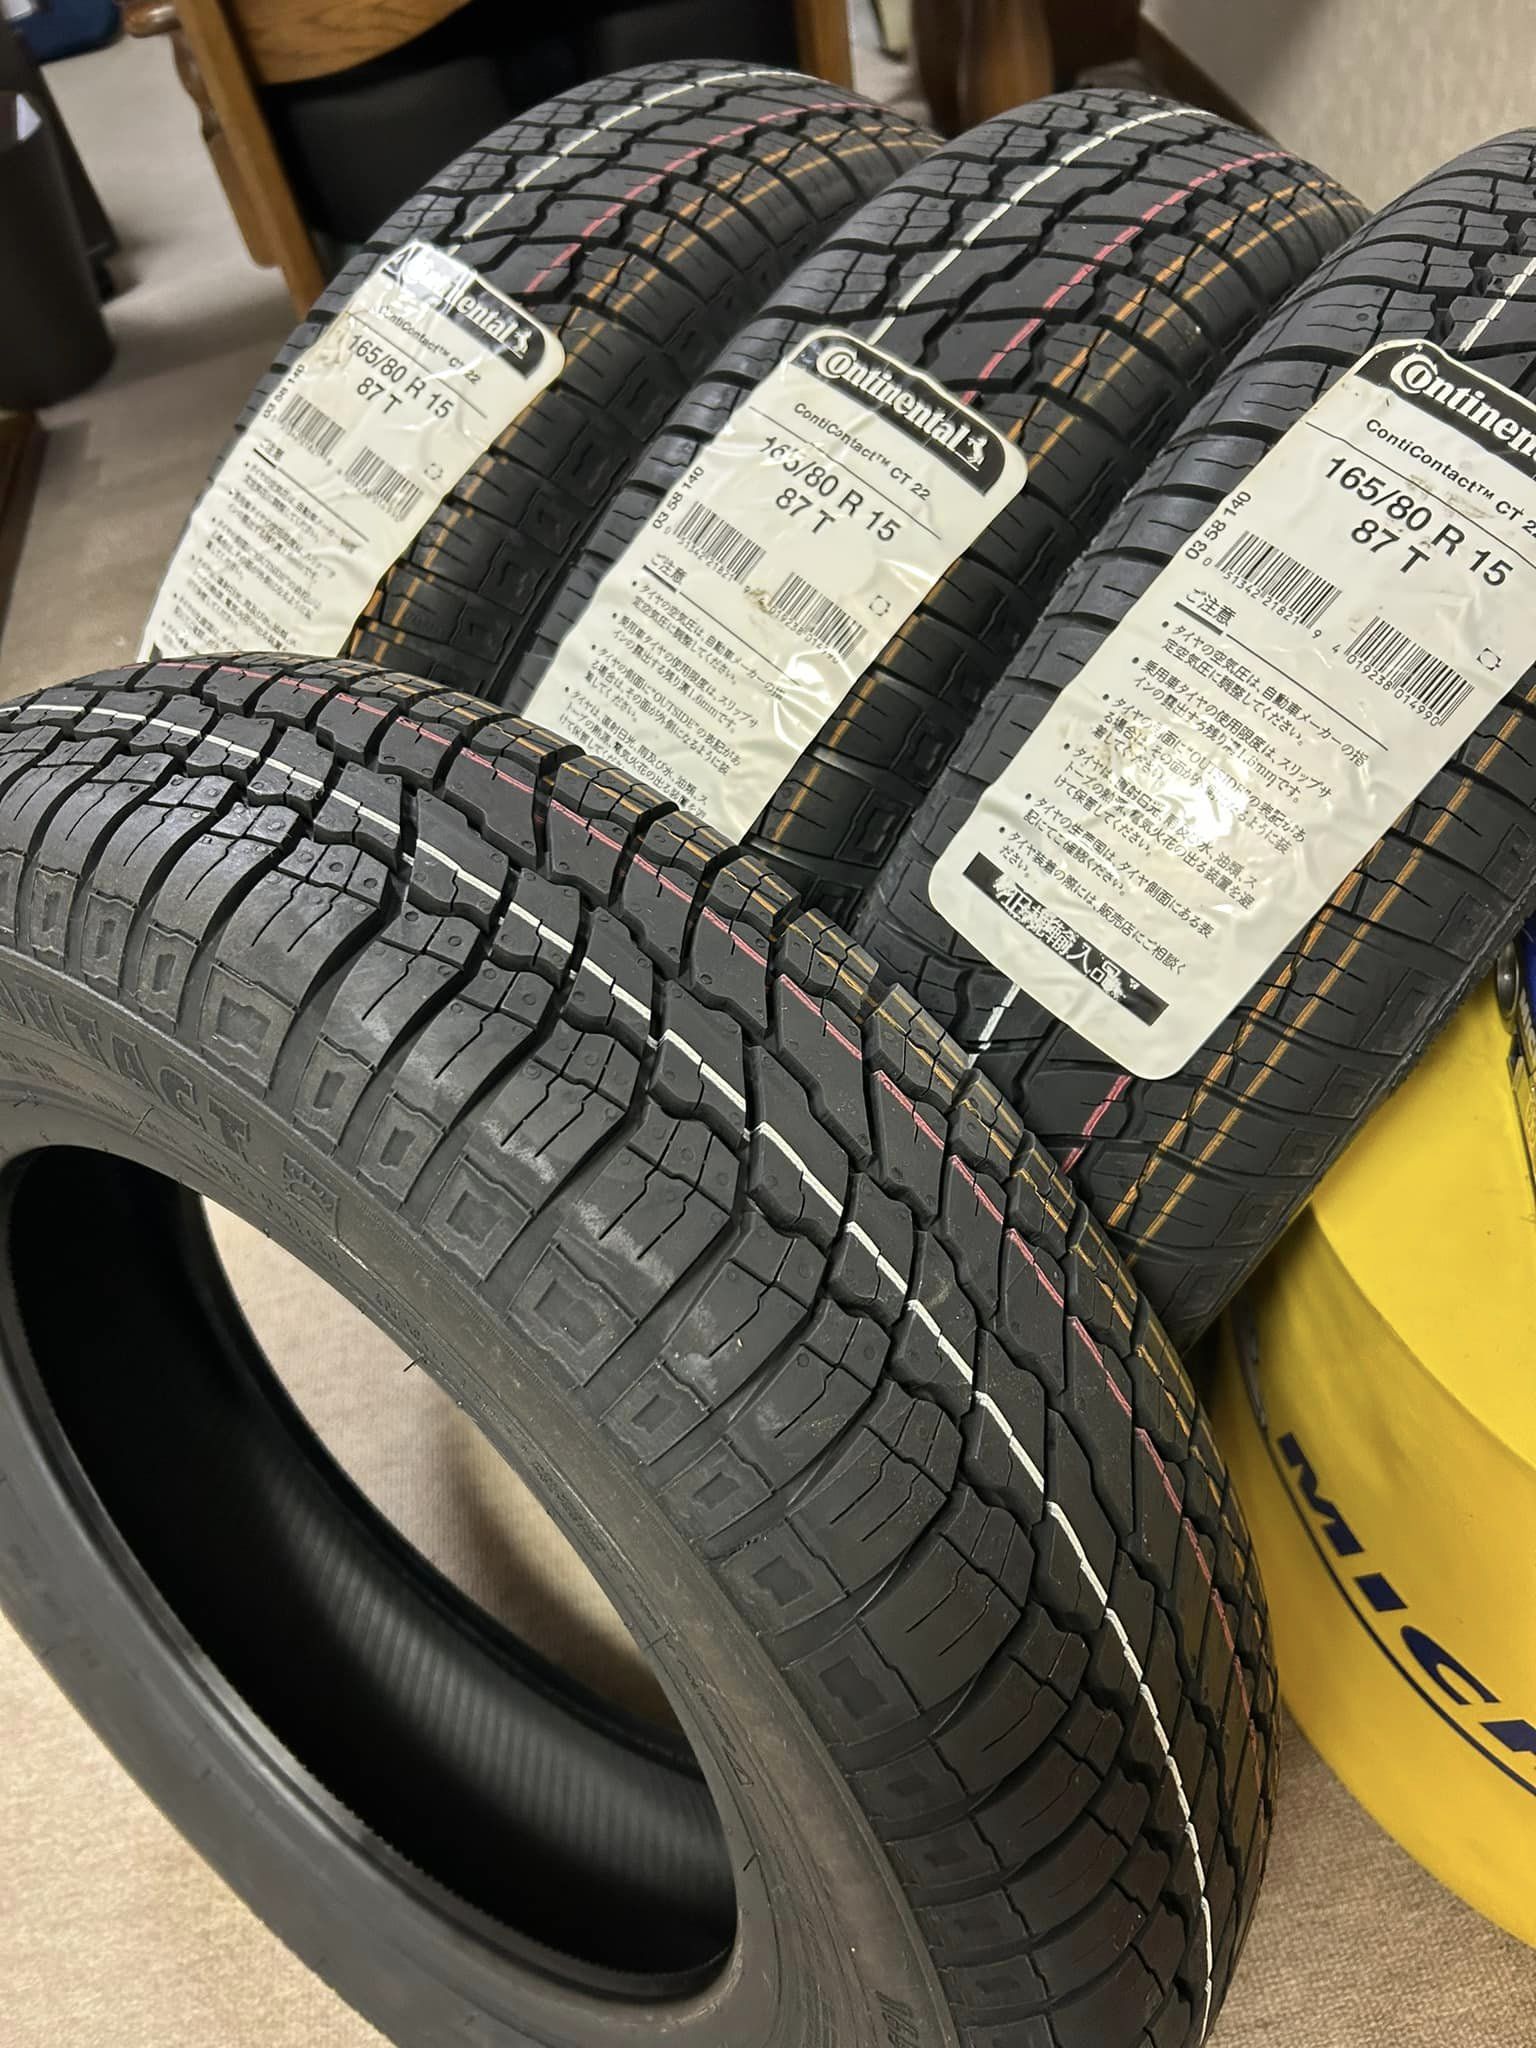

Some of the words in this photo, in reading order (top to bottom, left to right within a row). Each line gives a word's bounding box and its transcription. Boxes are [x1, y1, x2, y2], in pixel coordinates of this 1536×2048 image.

[347, 331, 408, 385] 165/80
[404, 375, 426, 399] R
[423, 390, 454, 420] 15
[354, 375, 385, 405] 87
[379, 394, 402, 418] T
[810, 334, 971, 452] Continental
[1390, 354, 1536, 464] Continen
[758, 432, 840, 499] 165/80
[837, 488, 864, 516] R
[862, 507, 901, 544] 15
[792, 399, 890, 471] ContiContact™
[888, 465, 911, 486] CT
[910, 481, 931, 501] 22
[1364, 417, 1494, 501] ContiContact™
[1493, 498, 1523, 524] CT
[651, 510, 669, 530] 03
[665, 490, 684, 511] 58
[681, 465, 705, 491] 140
[773, 484, 813, 522] 87
[808, 509, 835, 538] T
[1185, 539, 1208, 561] 03
[1205, 518, 1227, 542] 58
[1222, 490, 1252, 519] 140
[1321, 452, 1433, 535] 165/80
[1430, 521, 1466, 557] R
[1468, 551, 1513, 587] 15
[649, 550, 688, 586] ご注意
[1349, 514, 1399, 559] 87
[1395, 544, 1430, 580] T
[1184, 584, 1235, 627] ご注意
[1223, 570, 1261, 600] 51342
[1260, 595, 1299, 626] 21821
[1140, 658, 1333, 801] 乗用車タイヤの使用限度は、スリップサ
[1161, 637, 1309, 746] 定空気圧に調整してください。
[1170, 622, 1369, 768] タイヤの空気圧は、自動車メーカーの指
[1344, 652, 1395, 692] 019238
[1393, 687, 1441, 728] 014990
[1052, 773, 1155, 856] けて保管してください。
[1006, 830, 1187, 976] タイヤ装着の際には、販売店にご相談く
